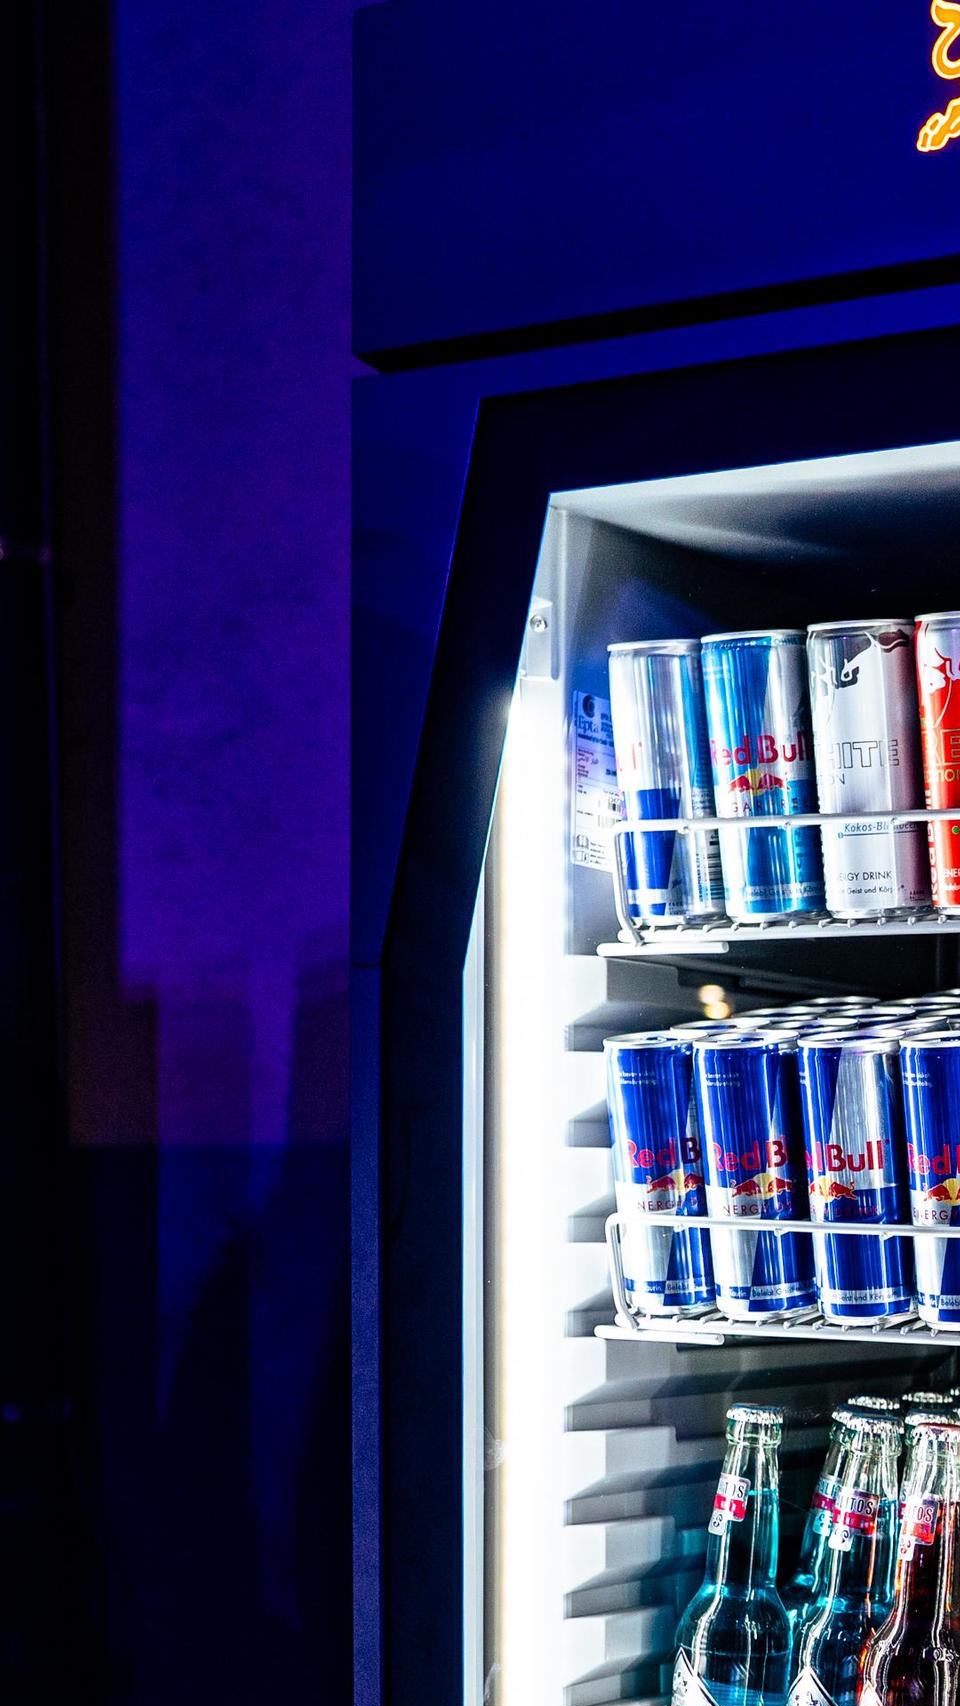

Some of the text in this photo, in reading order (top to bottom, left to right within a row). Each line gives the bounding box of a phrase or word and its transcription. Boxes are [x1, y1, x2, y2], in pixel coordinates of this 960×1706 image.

[862, 871, 892, 881] DRINK
[864, 886, 877, 895] und
[627, 1136, 676, 1168] Red
[712, 1140, 762, 1172] Red
[825, 1140, 884, 1172] Bull
